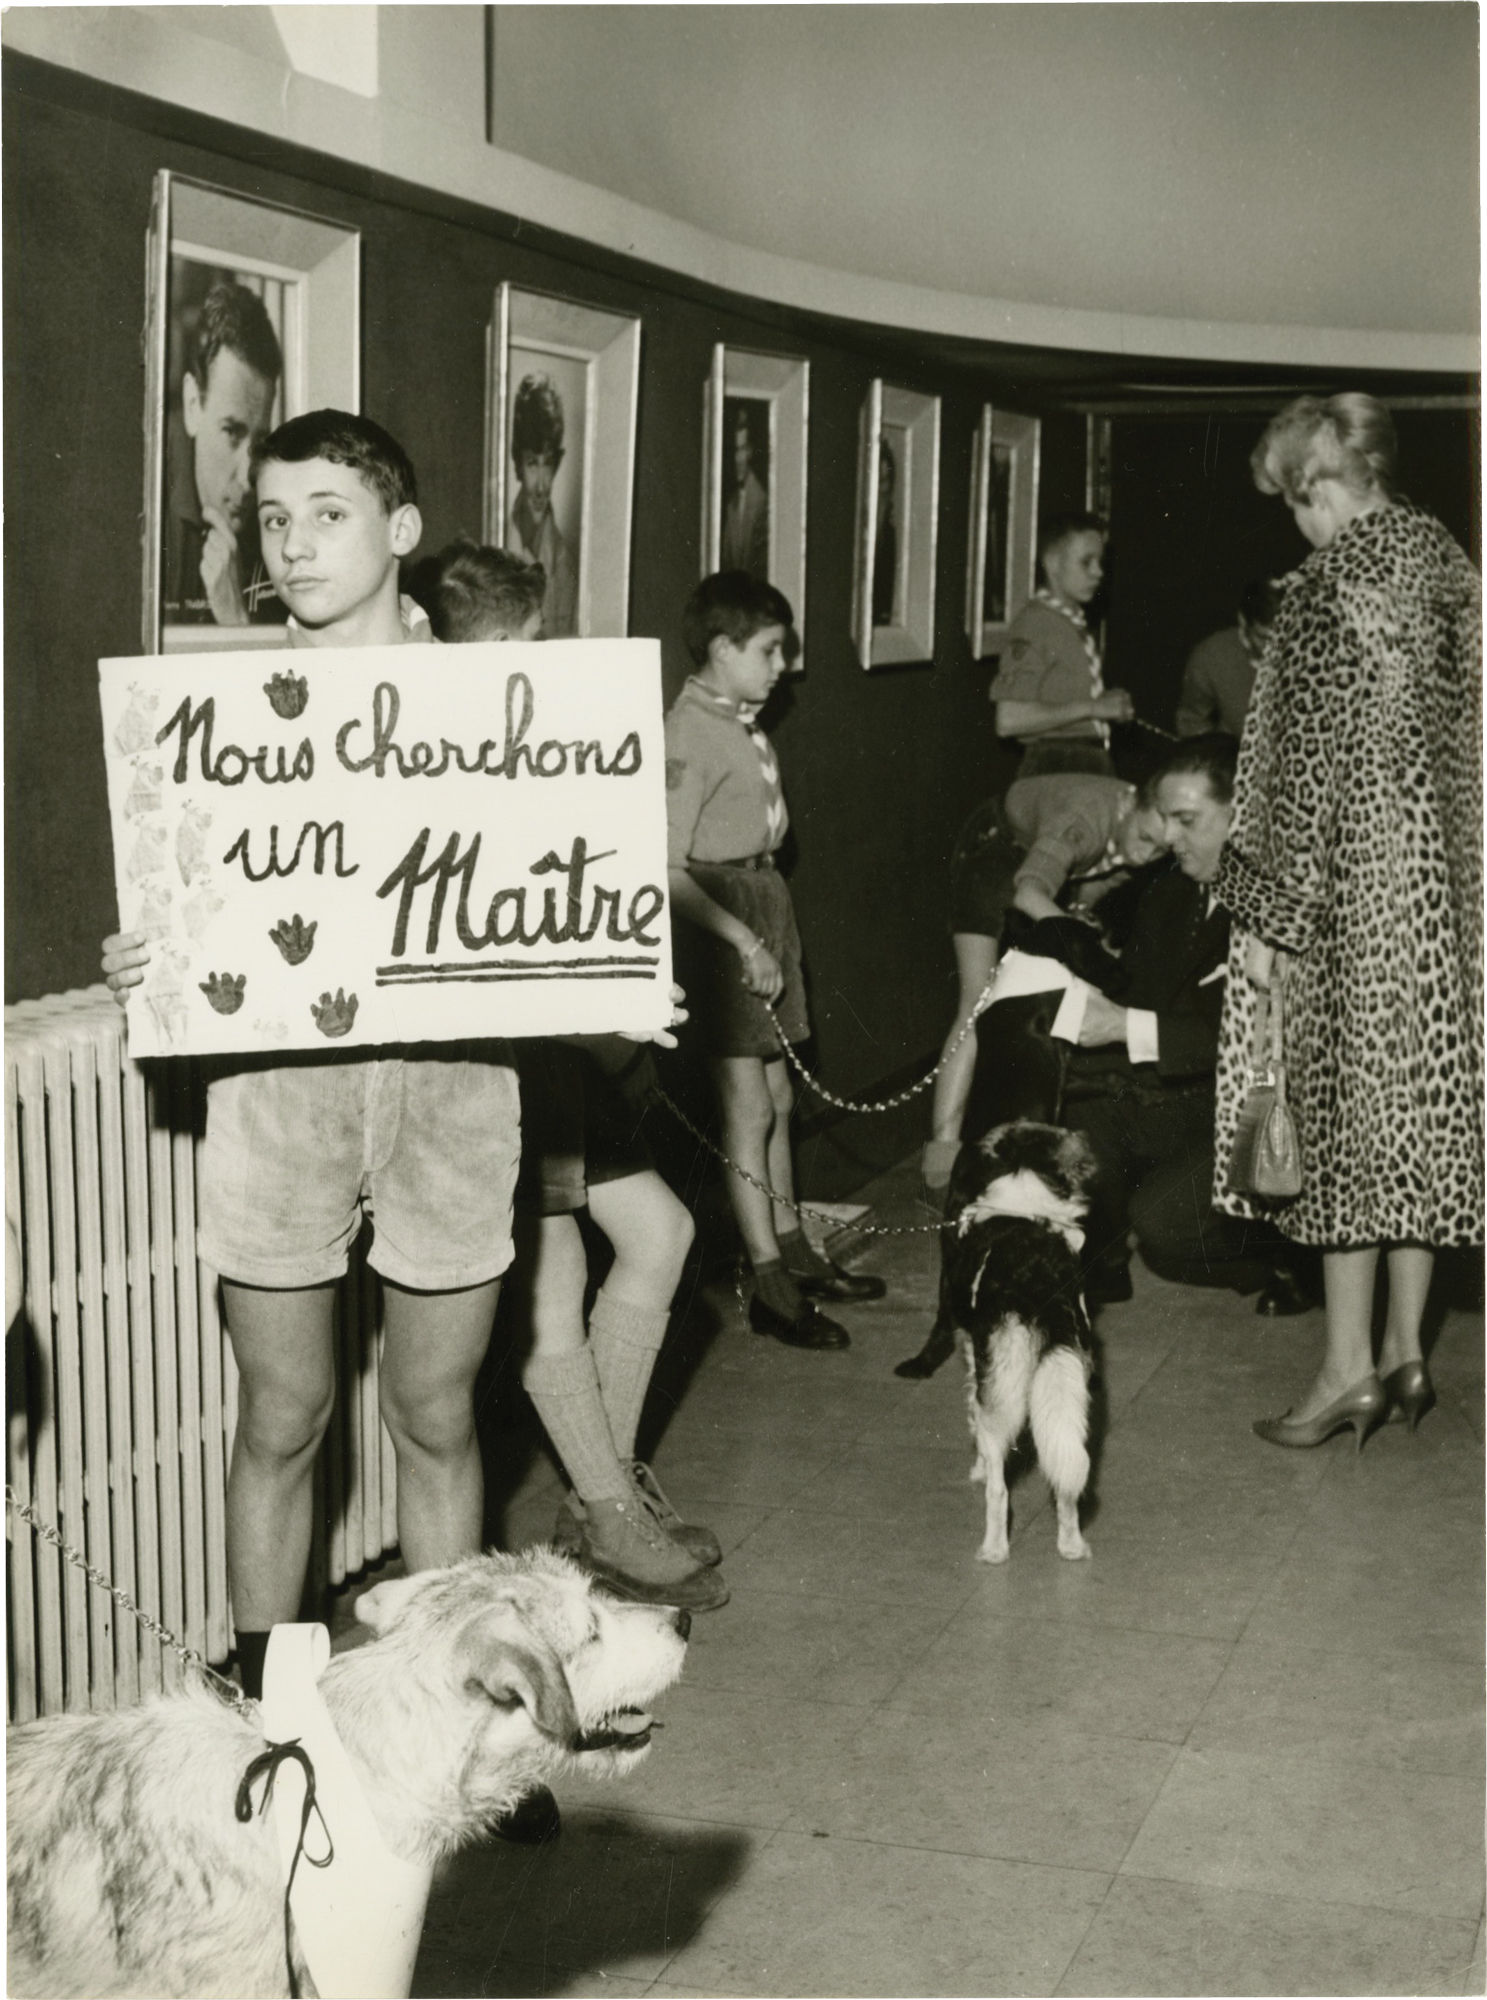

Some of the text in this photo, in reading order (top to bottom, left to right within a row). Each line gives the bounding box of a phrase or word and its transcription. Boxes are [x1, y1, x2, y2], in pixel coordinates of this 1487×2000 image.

[155, 695, 315, 787] Nous
[222, 820, 665, 957] un Maître
